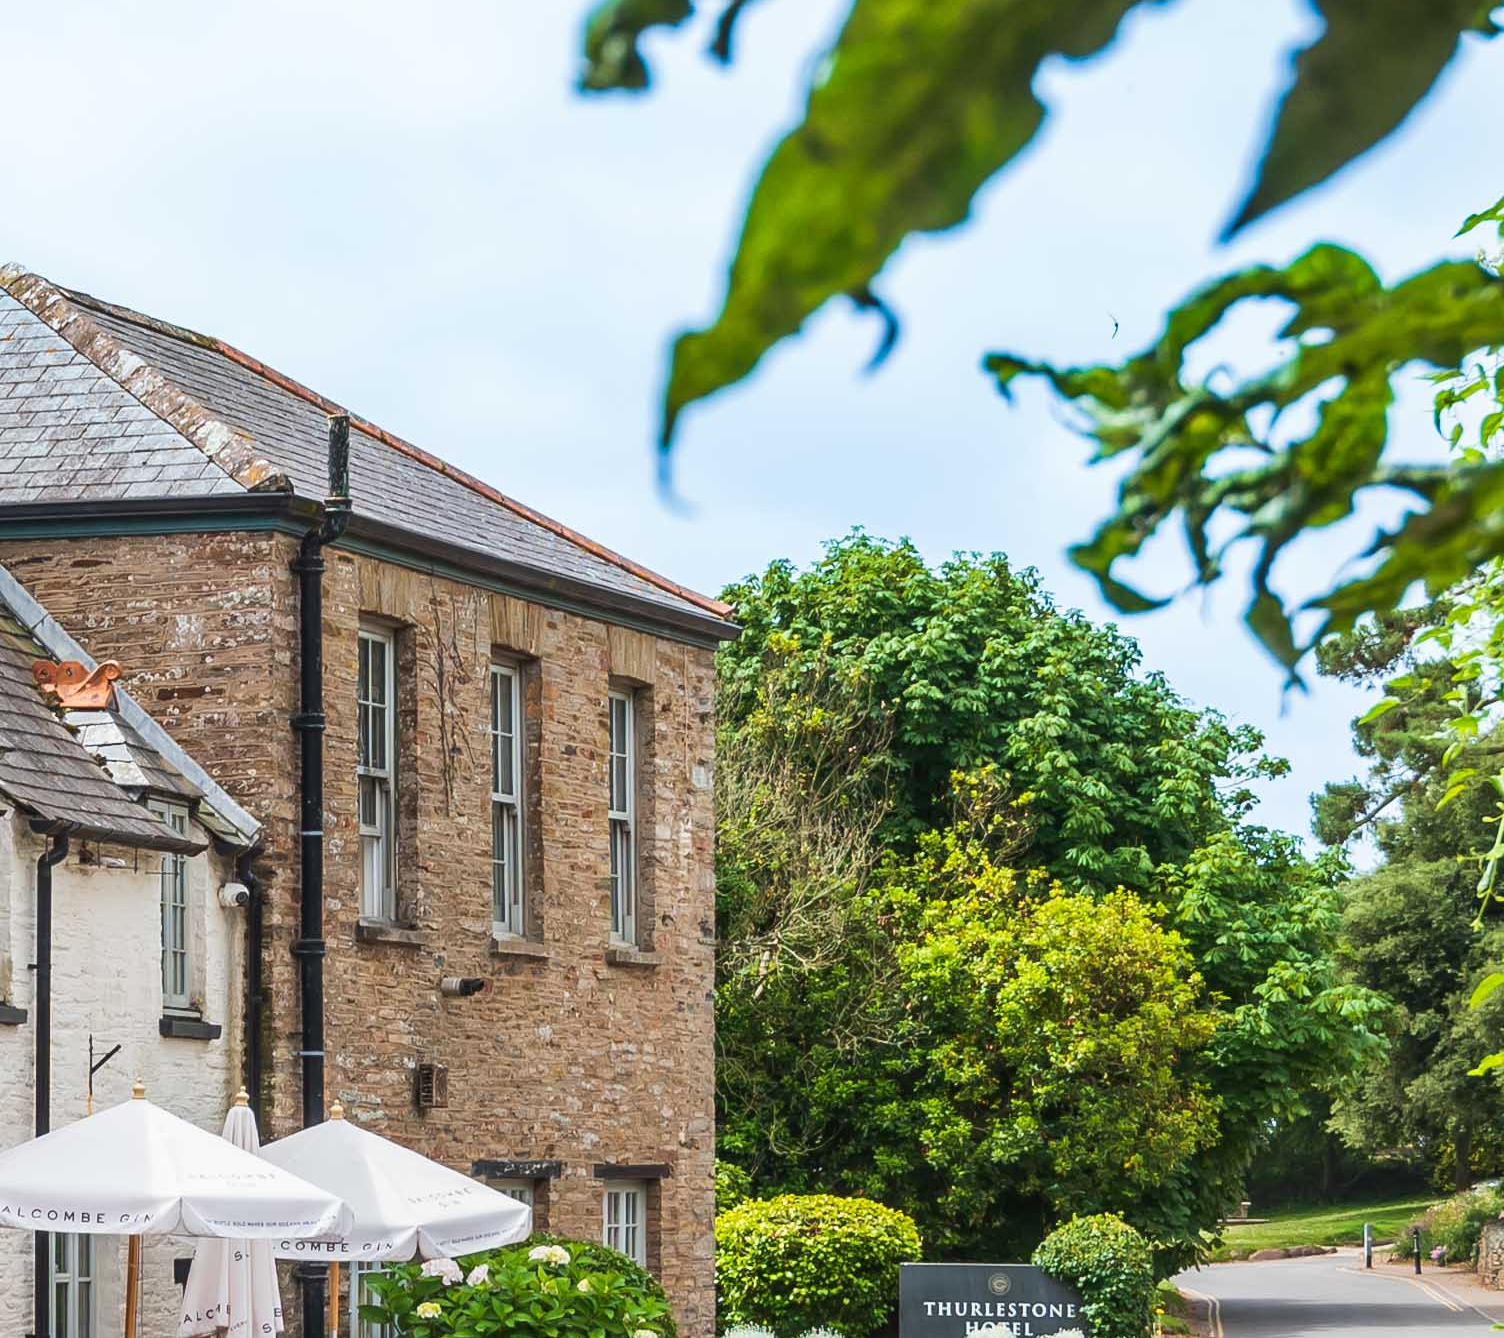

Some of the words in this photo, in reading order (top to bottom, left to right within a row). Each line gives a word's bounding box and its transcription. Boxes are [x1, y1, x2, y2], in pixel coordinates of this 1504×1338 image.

[119, 1213, 154, 1223] GIN
[280, 1240, 349, 1252] COMBE
[923, 1301, 1077, 1318] THURLESTONE
